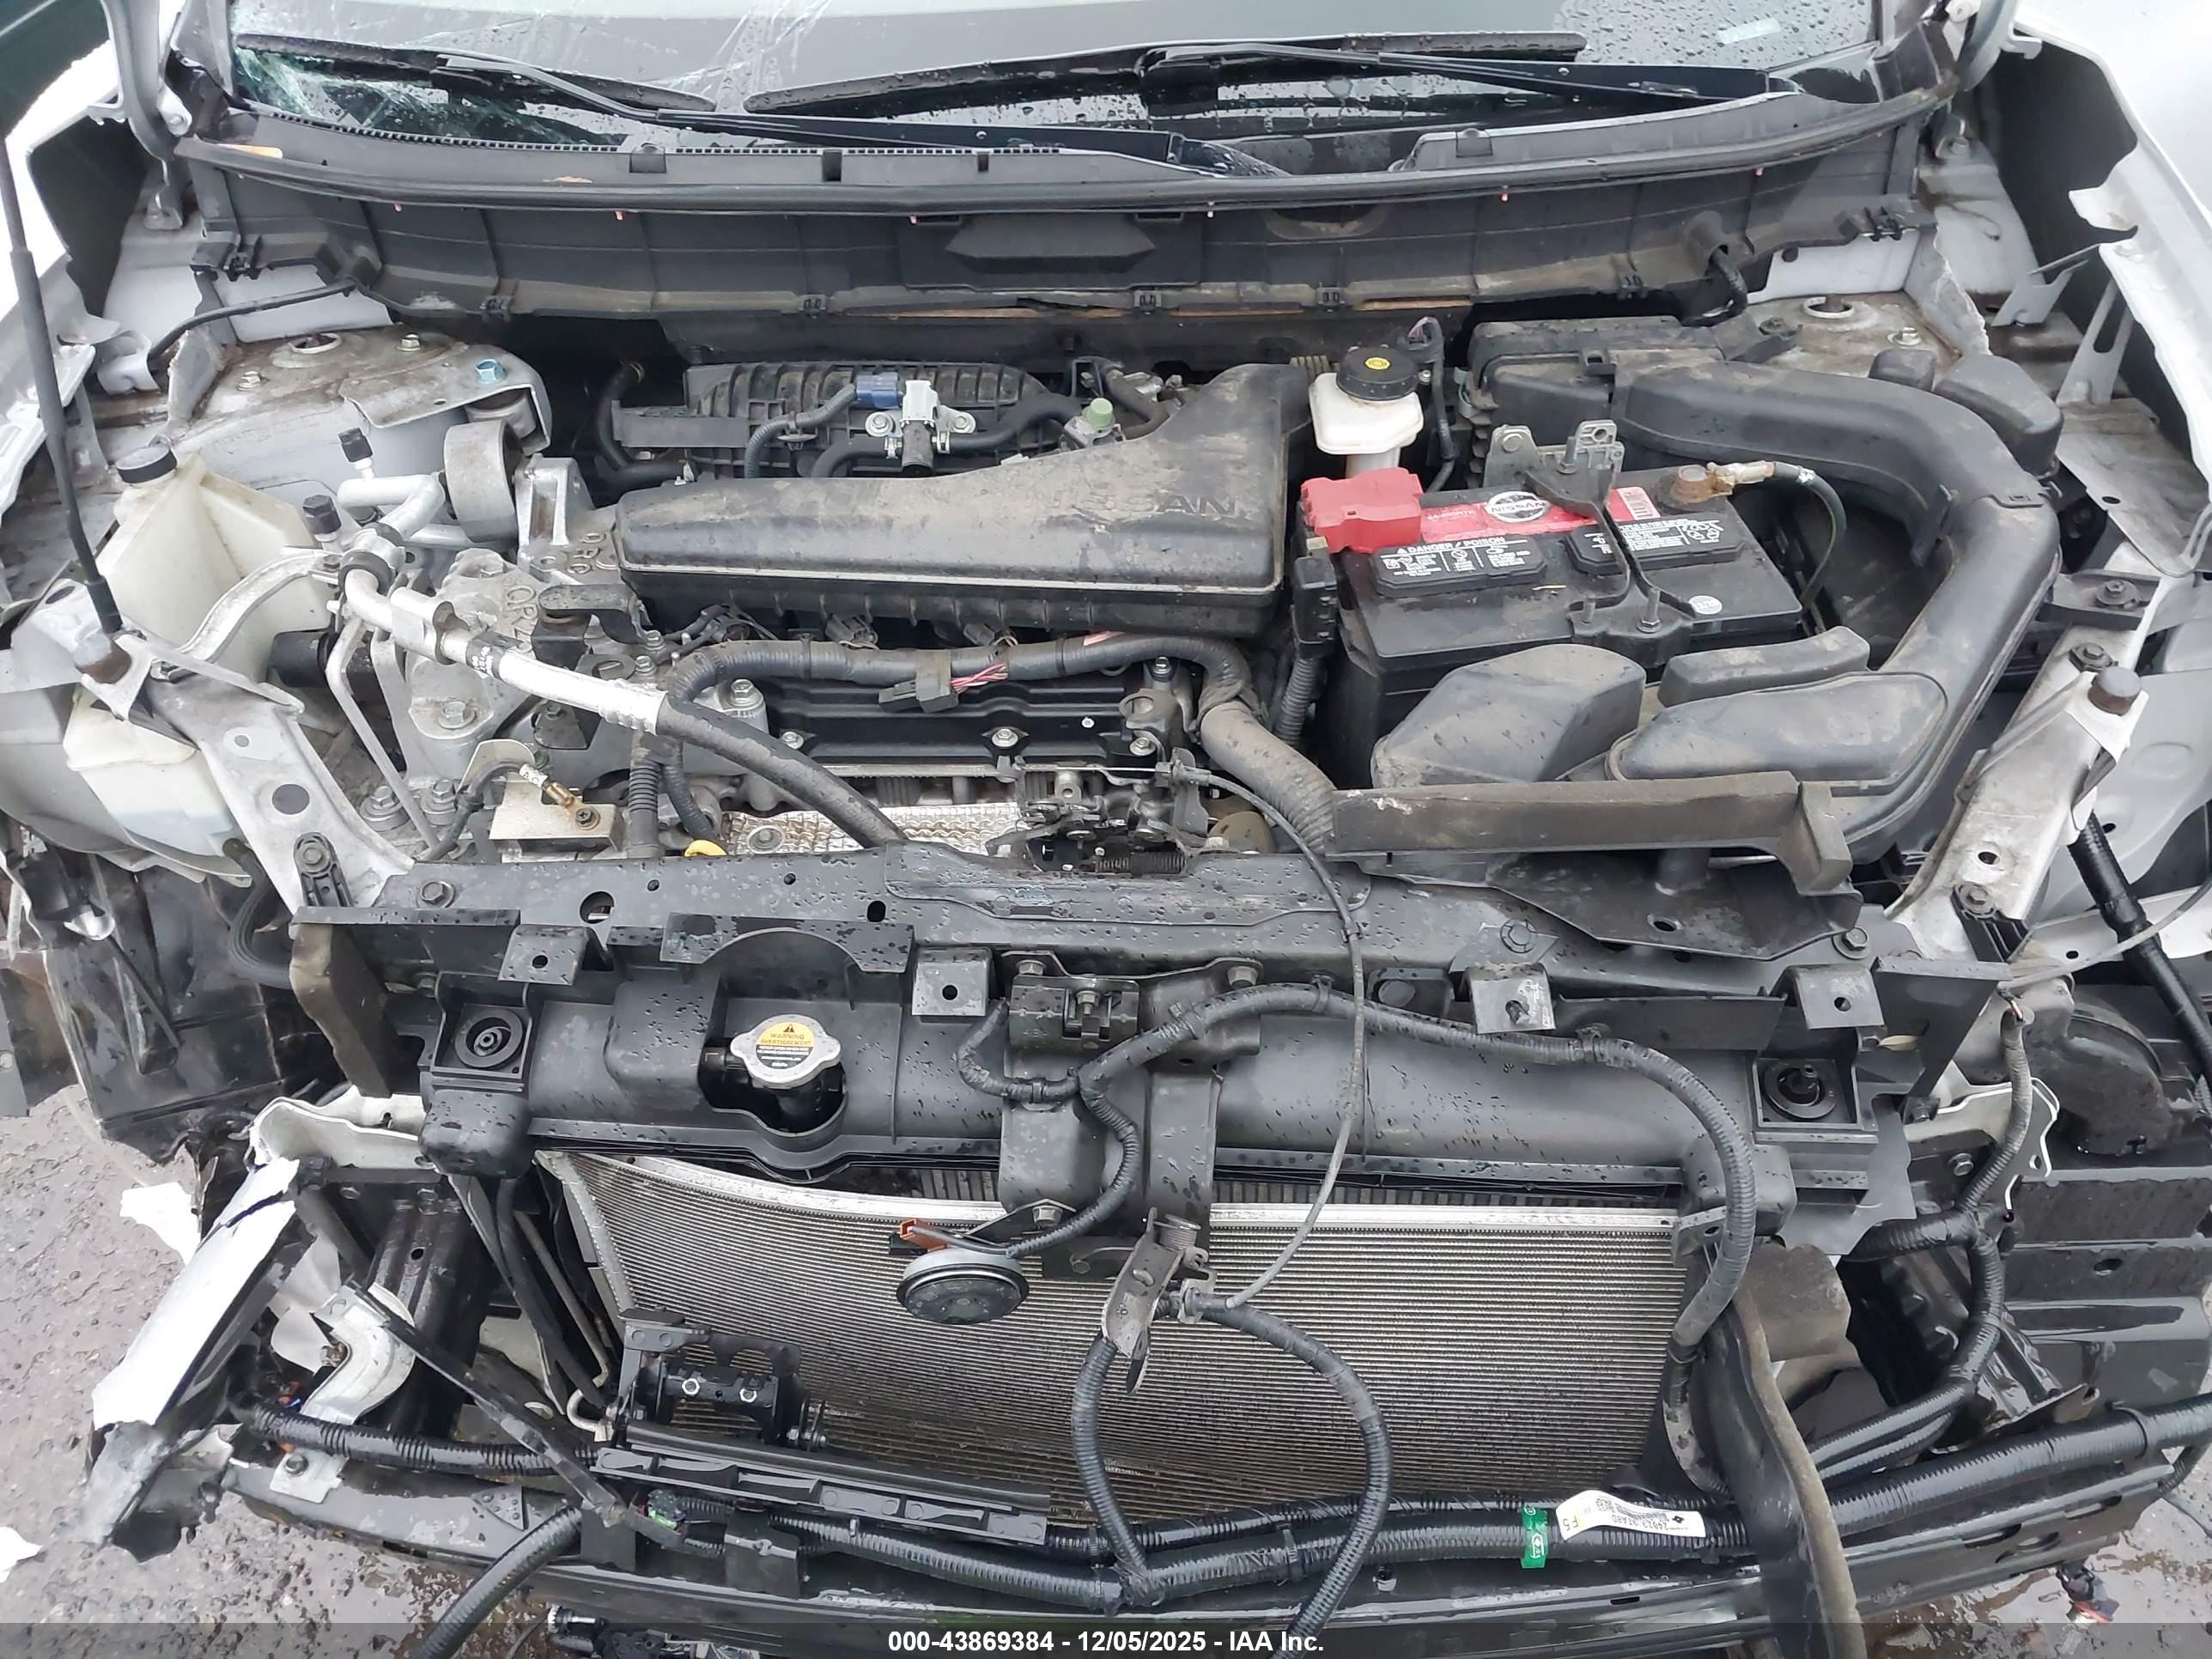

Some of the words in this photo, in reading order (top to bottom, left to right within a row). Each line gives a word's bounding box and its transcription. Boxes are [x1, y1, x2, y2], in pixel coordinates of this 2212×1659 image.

[1491, 501, 1547, 514] NISSAN
[1407, 543, 1453, 553] DANGER
[1463, 537, 1505, 547] POISON
